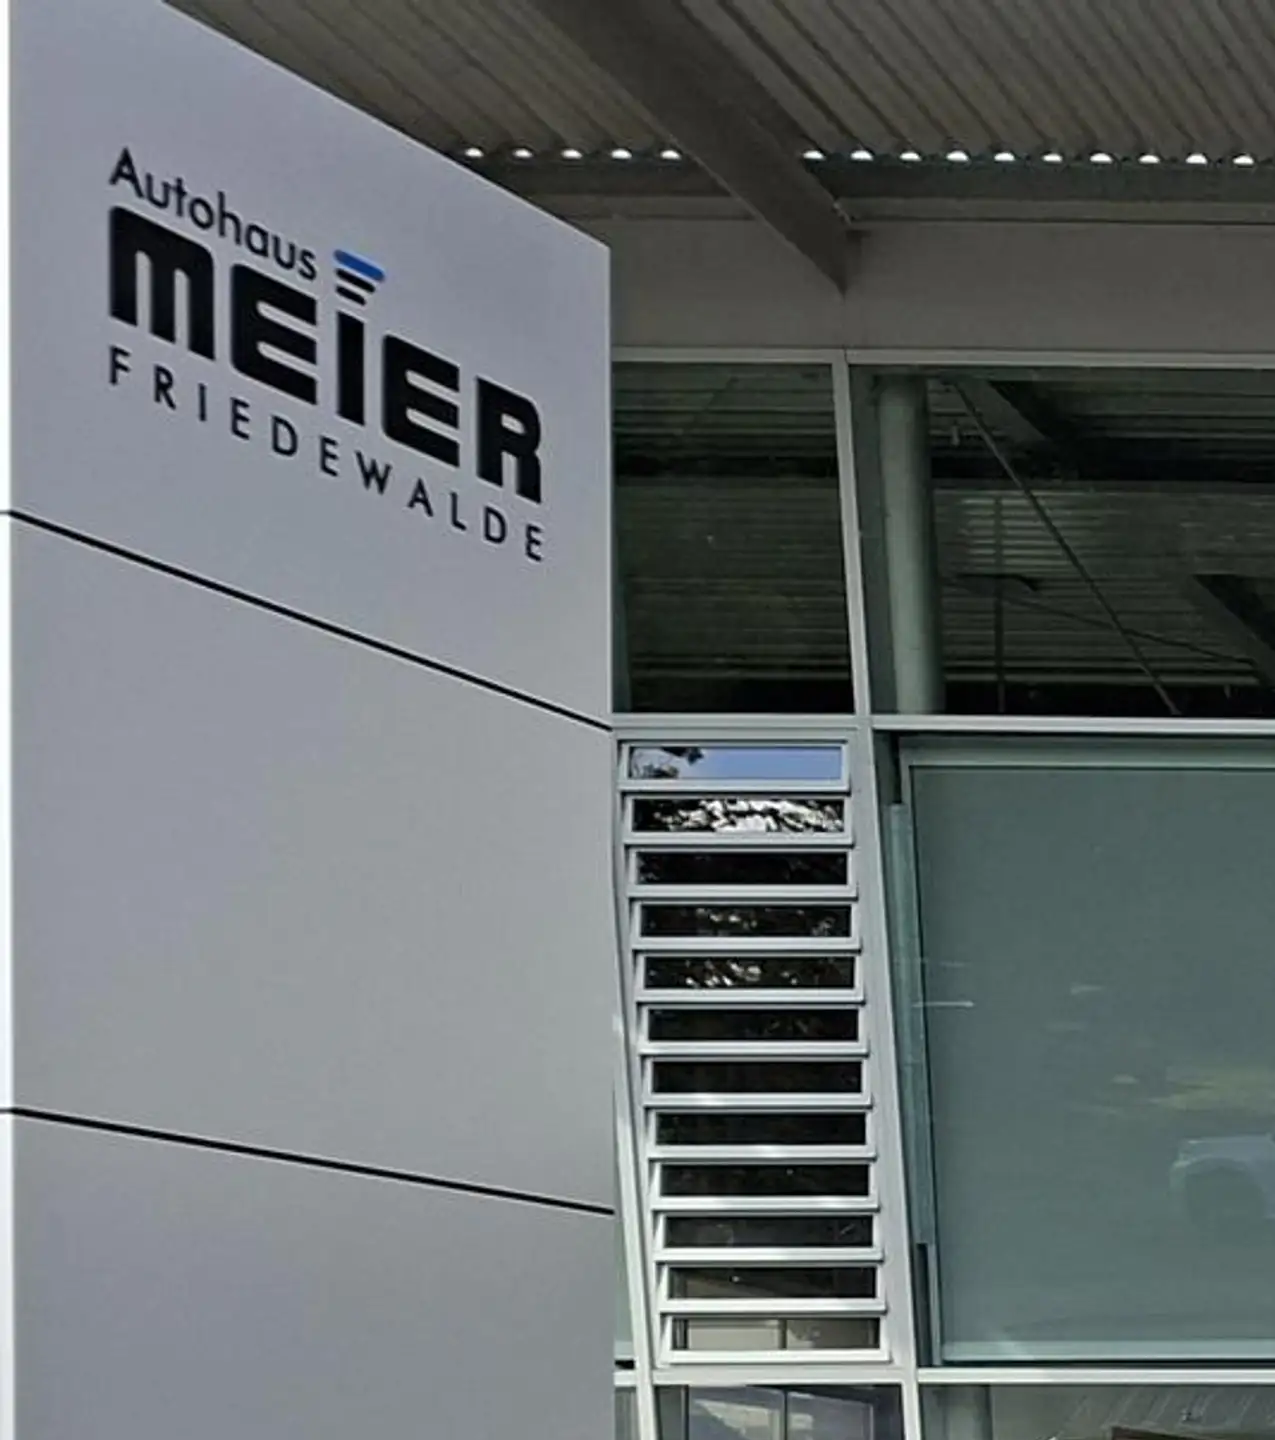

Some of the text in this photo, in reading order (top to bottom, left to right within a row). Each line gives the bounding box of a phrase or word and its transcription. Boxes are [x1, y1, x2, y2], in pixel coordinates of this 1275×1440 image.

[108, 147, 318, 281] Autohaus
[108, 205, 543, 505] MEIER
[108, 345, 544, 562] FRIEDEWALDE
